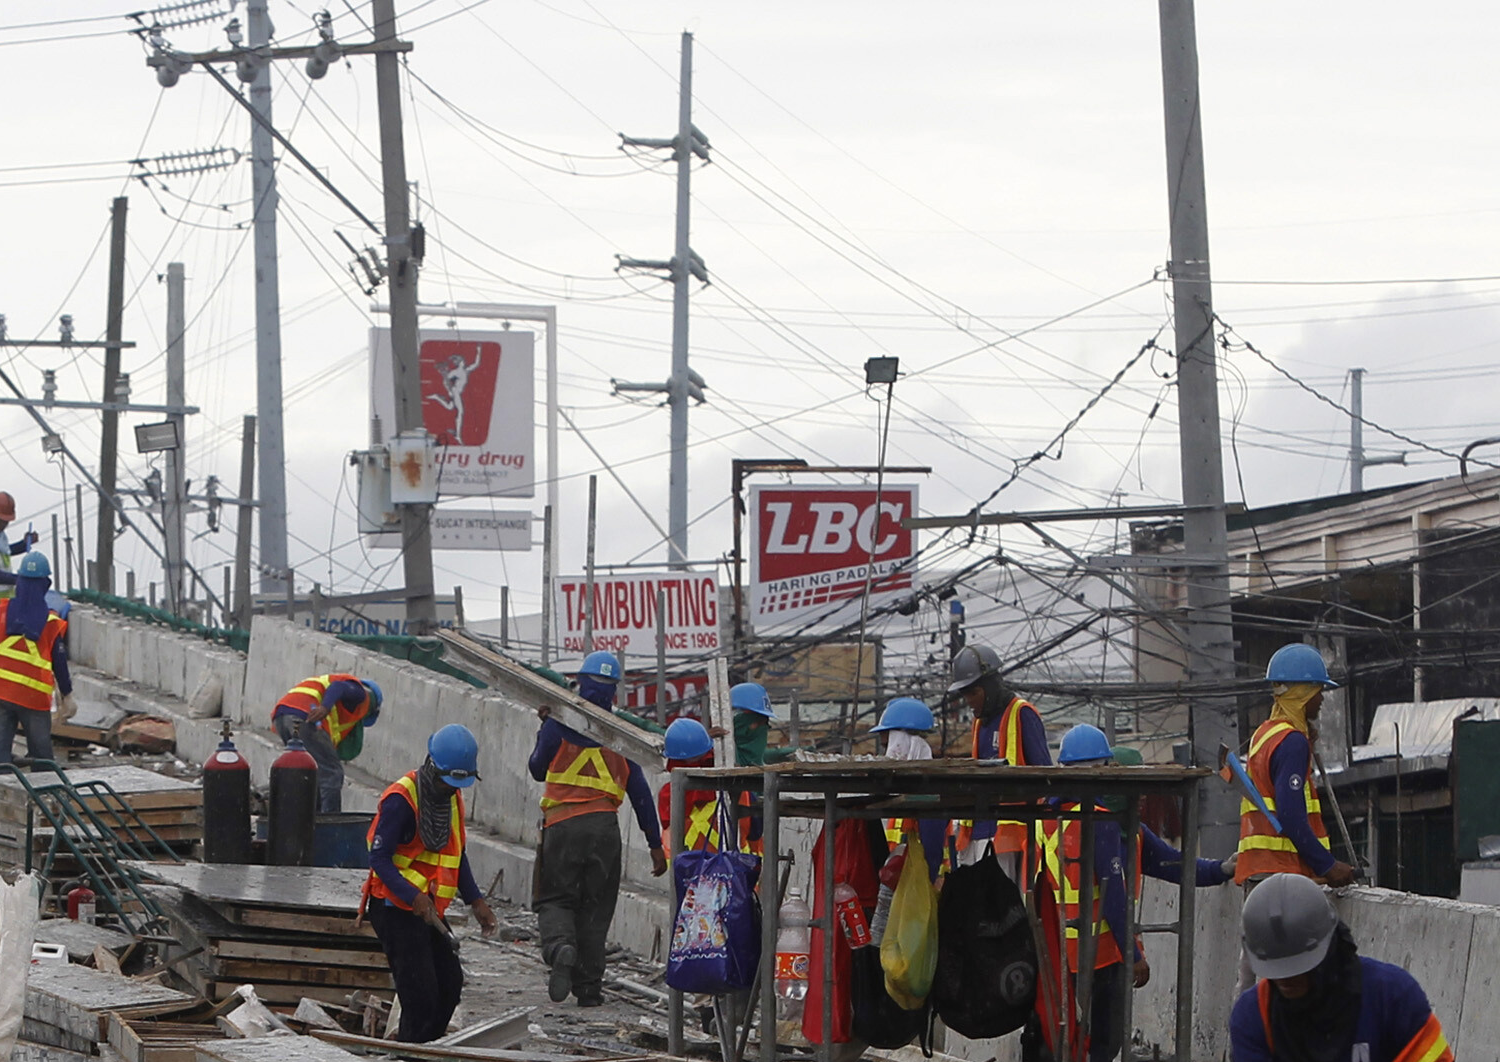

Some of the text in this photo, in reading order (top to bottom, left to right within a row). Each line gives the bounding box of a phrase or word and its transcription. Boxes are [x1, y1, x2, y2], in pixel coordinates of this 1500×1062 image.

[477, 450, 525, 469] drug
[465, 518, 528, 530] INTERCHANGE
[765, 501, 904, 555] LBC
[768, 578, 805, 594] HARI
[809, 573, 832, 586] NG
[561, 578, 717, 631] TAMBUNTING
[691, 633, 718, 649] 1906
